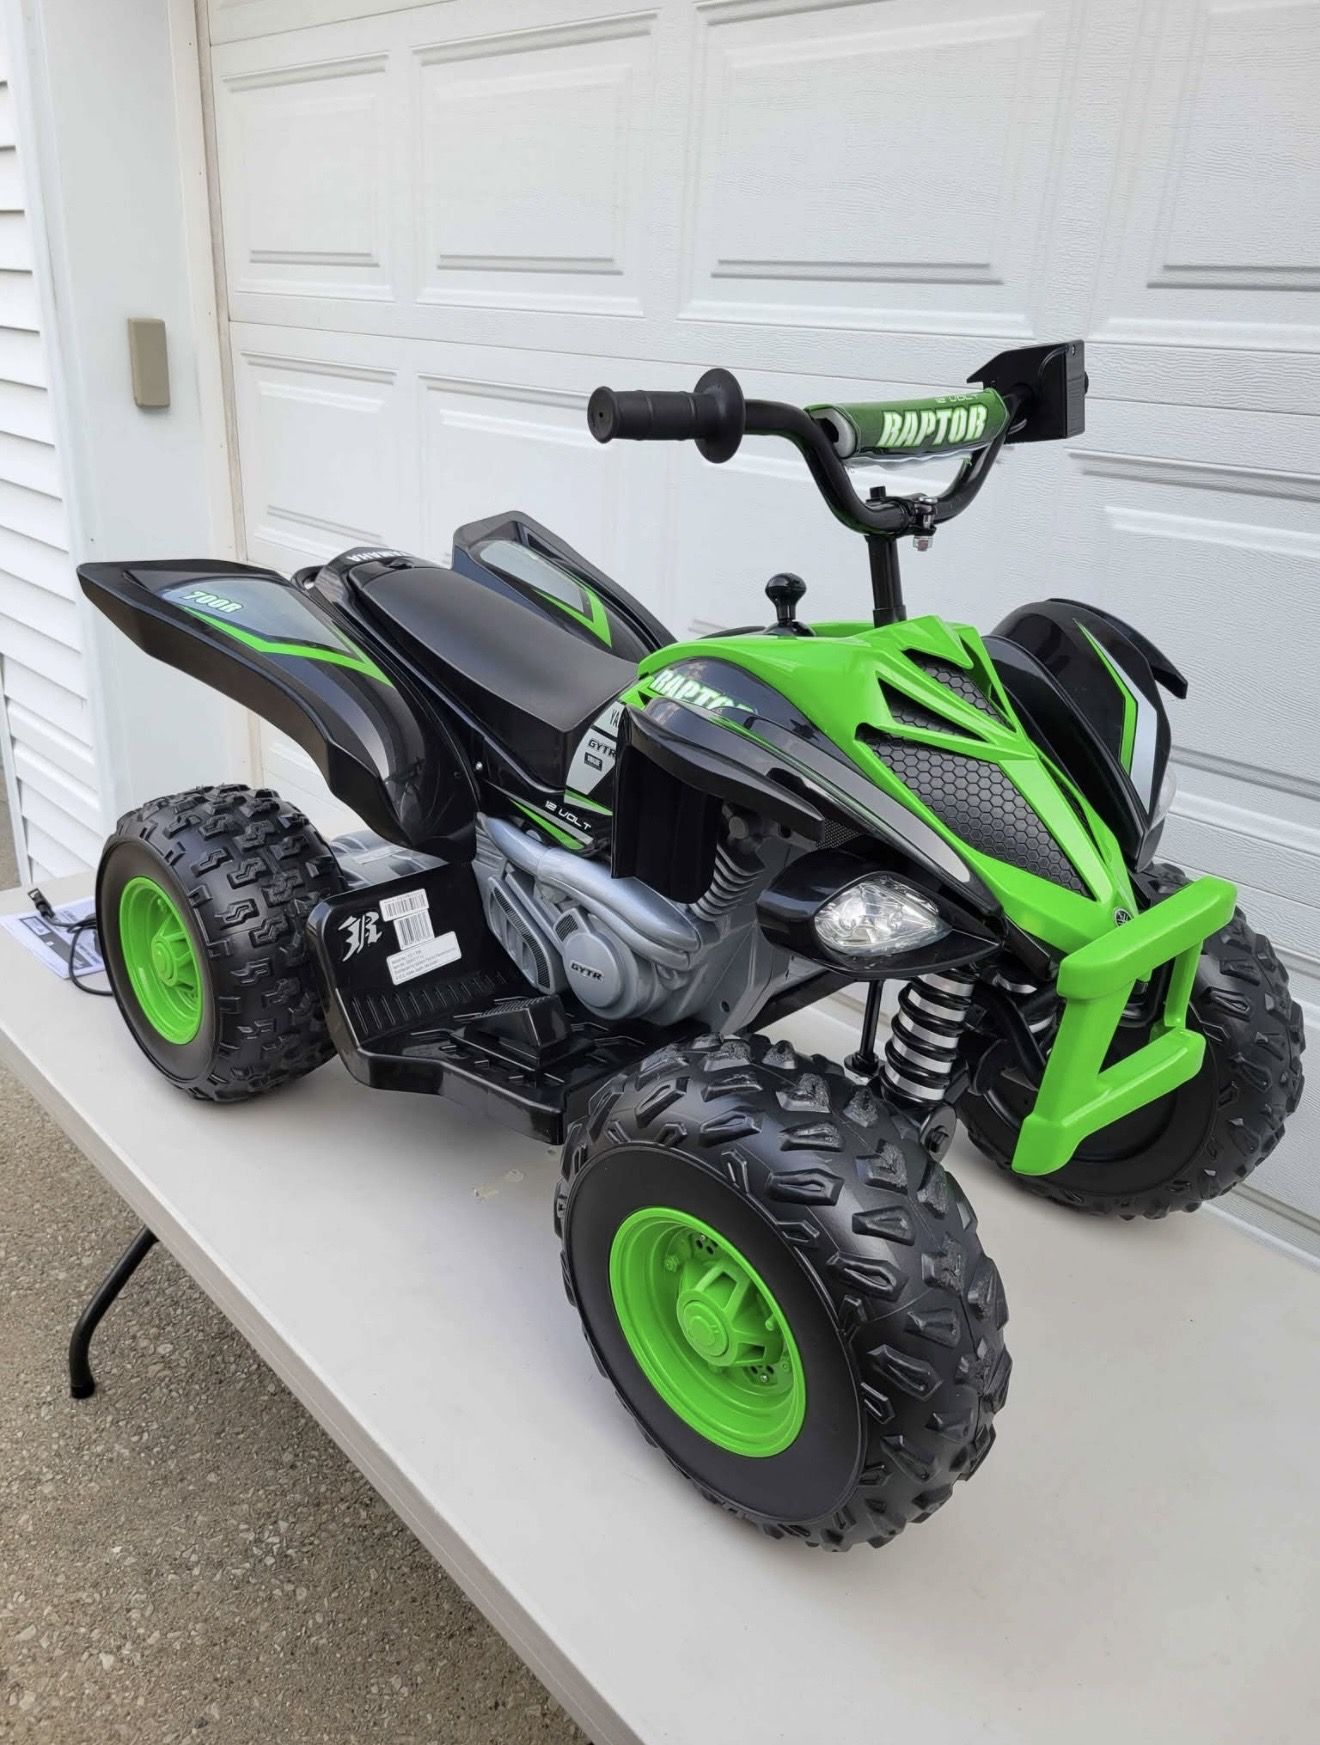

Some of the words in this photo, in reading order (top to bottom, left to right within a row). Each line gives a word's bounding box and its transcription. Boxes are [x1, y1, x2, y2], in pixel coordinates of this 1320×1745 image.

[876, 404, 988, 447] RAPTOR
[181, 591, 242, 613] 700R
[545, 800, 557, 812] 12
[558, 808, 592, 830] VOLT
[571, 962, 602, 981] GYTR
